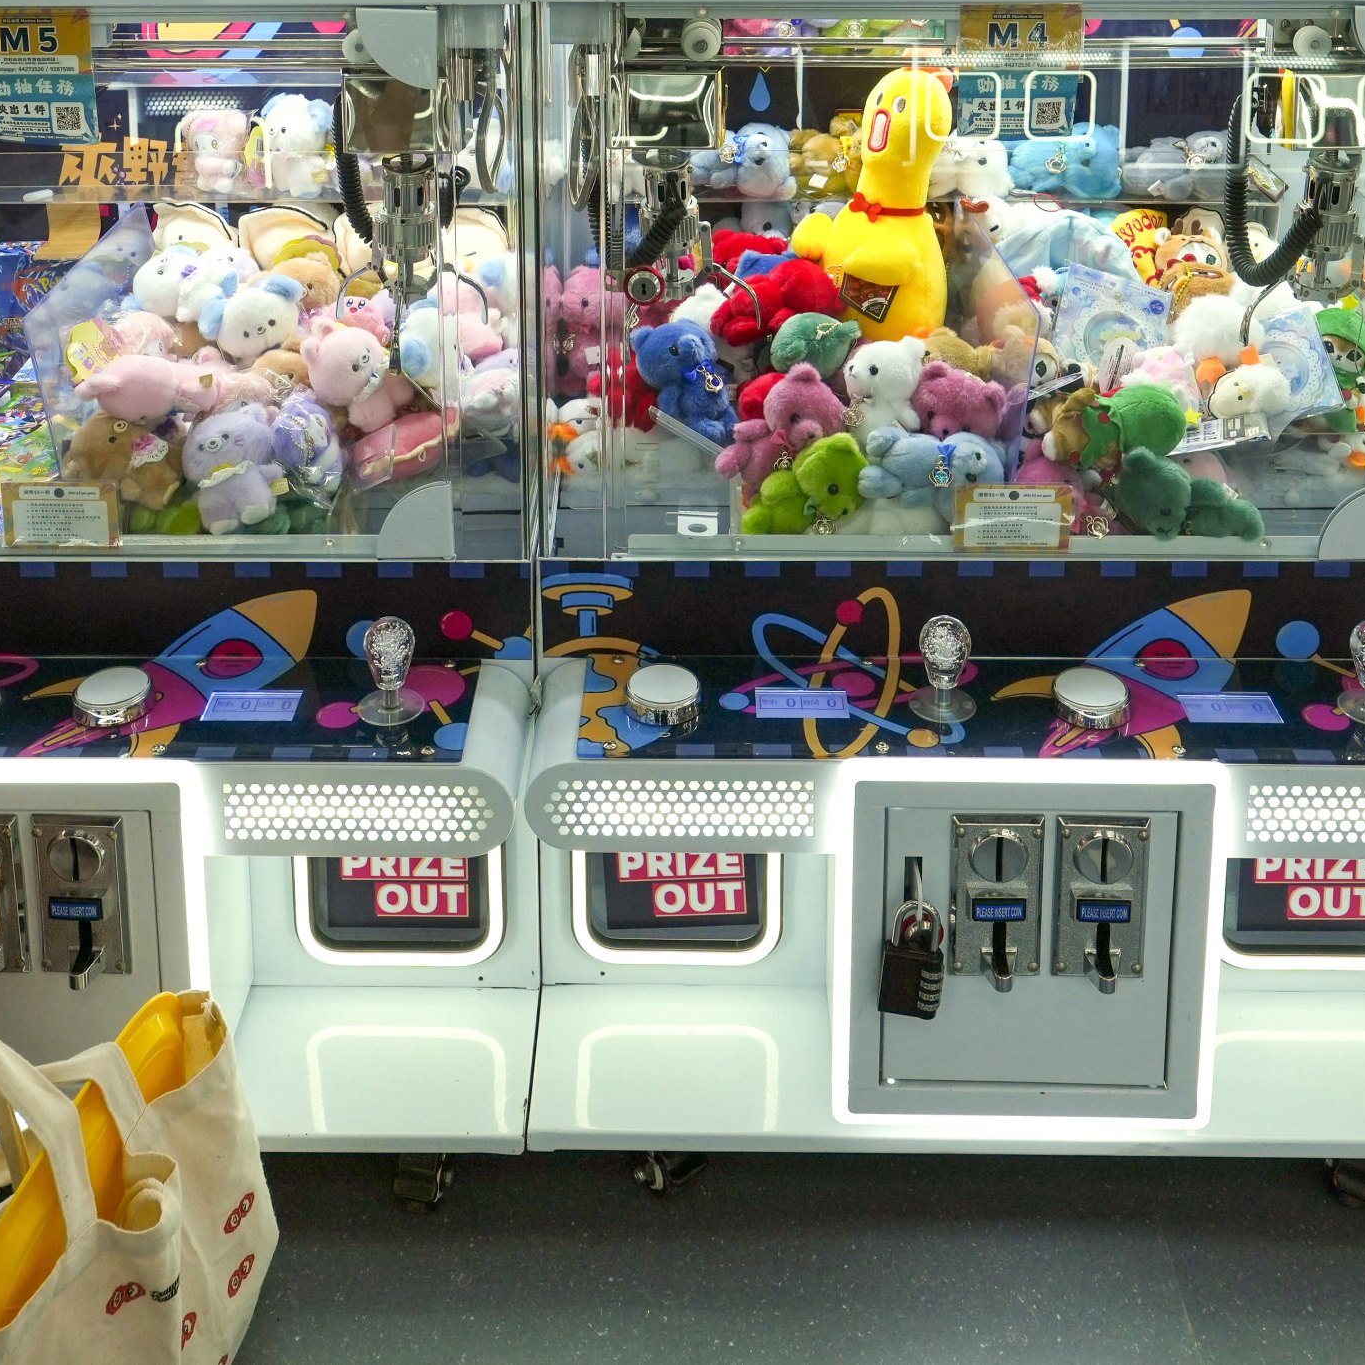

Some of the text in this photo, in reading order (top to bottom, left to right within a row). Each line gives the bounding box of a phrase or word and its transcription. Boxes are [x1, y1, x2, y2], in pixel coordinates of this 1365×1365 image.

[342, 857, 465, 877] PRIZE
[619, 853, 741, 878] PRIZE
[376, 884, 465, 914] OUT
[655, 881, 742, 914] OUT
[52, 907, 97, 916] PLEASE INSERT COIN
[976, 907, 1022, 917] PLEASE INSERT COIN
[1081, 908, 1128, 919] PLEASE INSERT COIN
